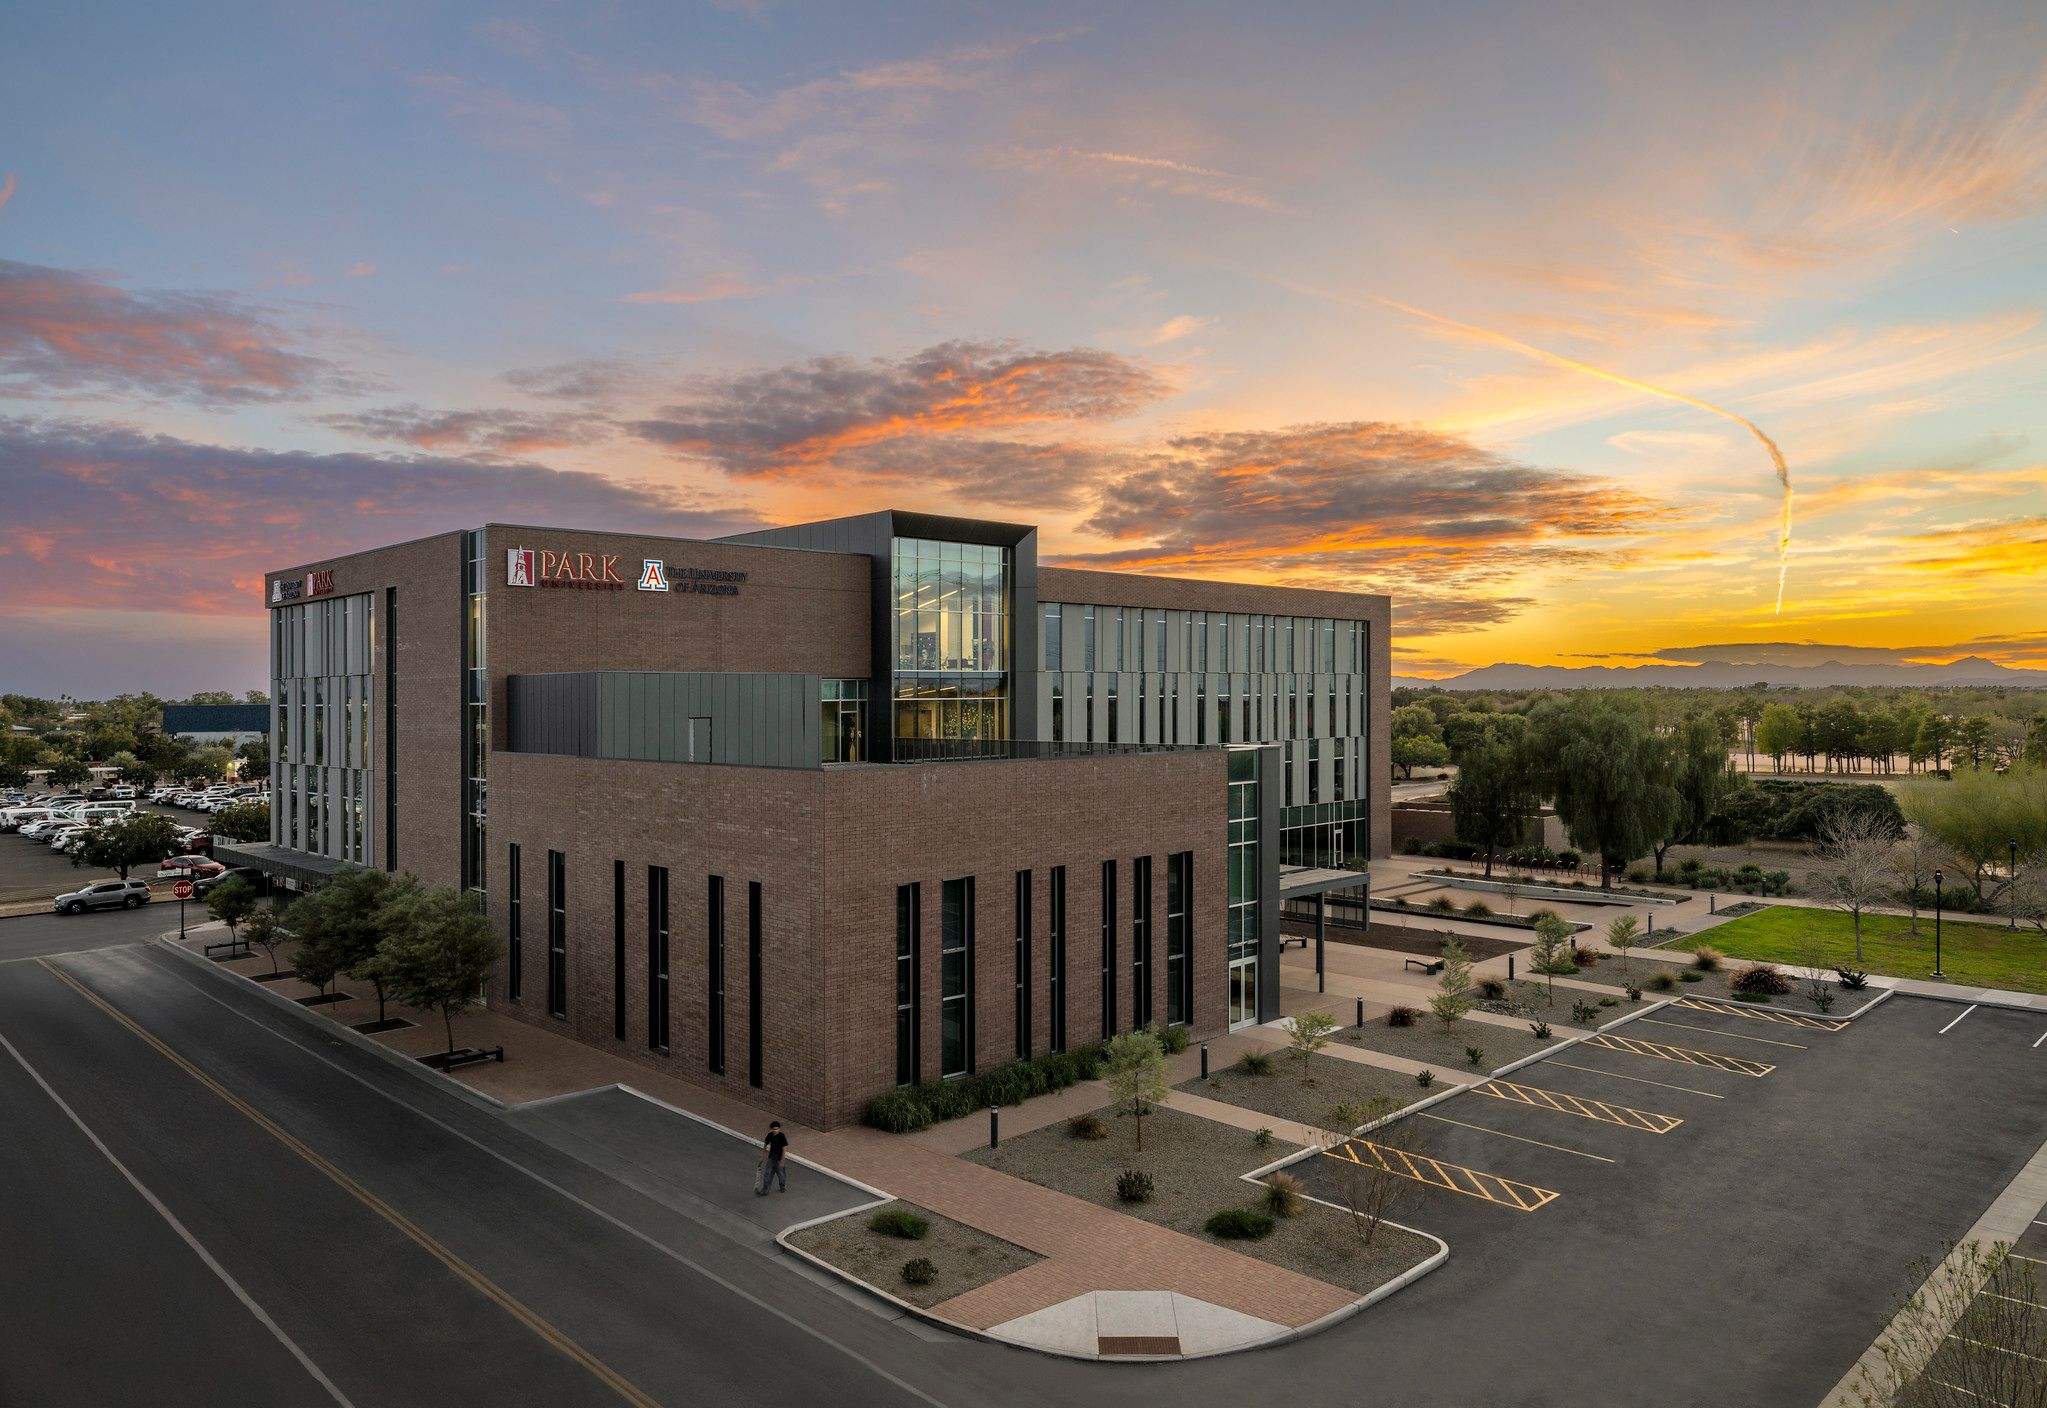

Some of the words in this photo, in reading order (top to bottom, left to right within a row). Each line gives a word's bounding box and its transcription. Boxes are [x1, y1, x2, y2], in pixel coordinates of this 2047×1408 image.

[540, 550, 625, 582] PARK
[666, 566, 687, 578] THE
[689, 567, 748, 582] UNIVERSITY
[313, 570, 334, 589] PARK
[638, 559, 668, 592] A
[540, 579, 625, 591] UNIVERSITY
[673, 583, 689, 592] OF
[174, 885, 192, 894] STOP
